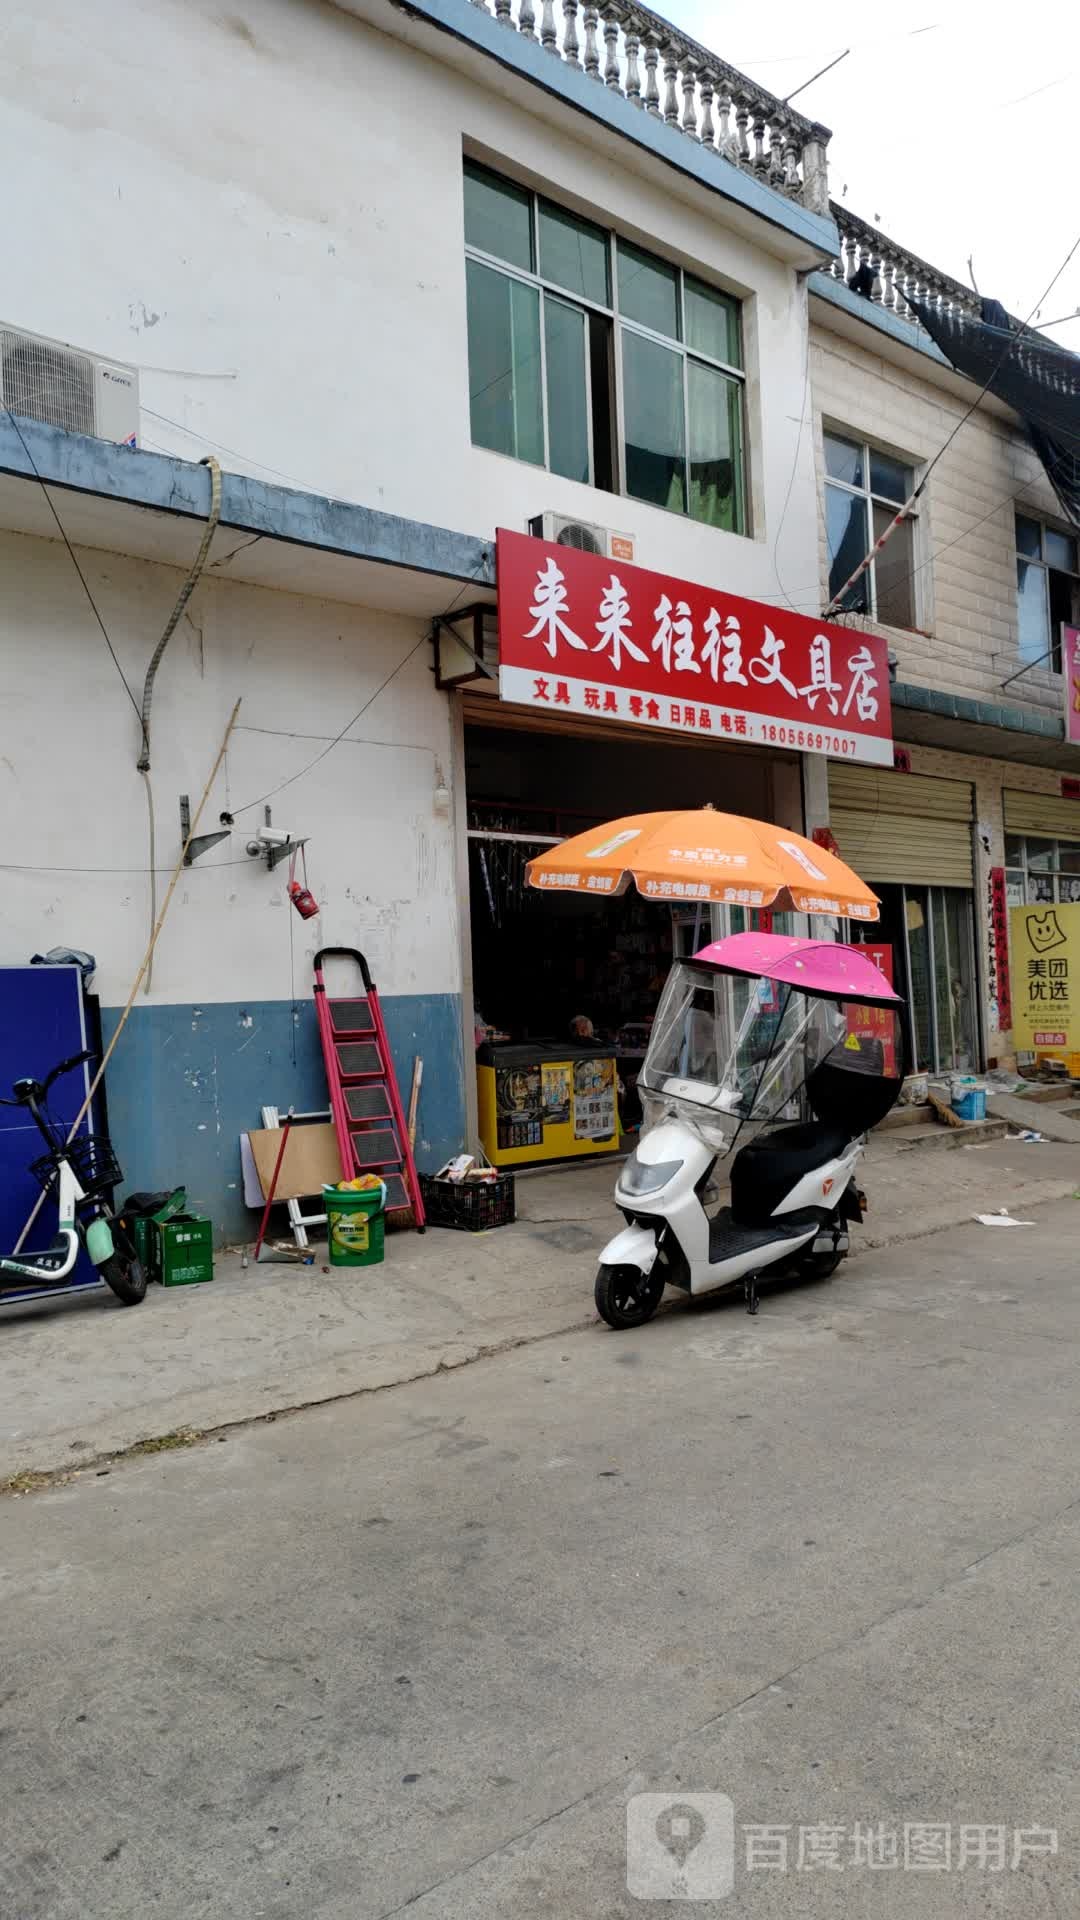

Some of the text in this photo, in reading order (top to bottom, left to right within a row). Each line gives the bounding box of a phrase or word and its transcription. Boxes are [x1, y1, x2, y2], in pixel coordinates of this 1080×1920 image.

[522, 556, 879, 722] 来来往往文具店
[533, 677, 571, 705] 文具
[584, 687, 618, 713] 玩具
[629, 695, 660, 721] 零食
[670, 703, 712, 729] 日用品
[761, 724, 857, 755] 18056697007
[1027, 958, 1068, 979] 美团
[1028, 980, 1069, 1001] 优选
